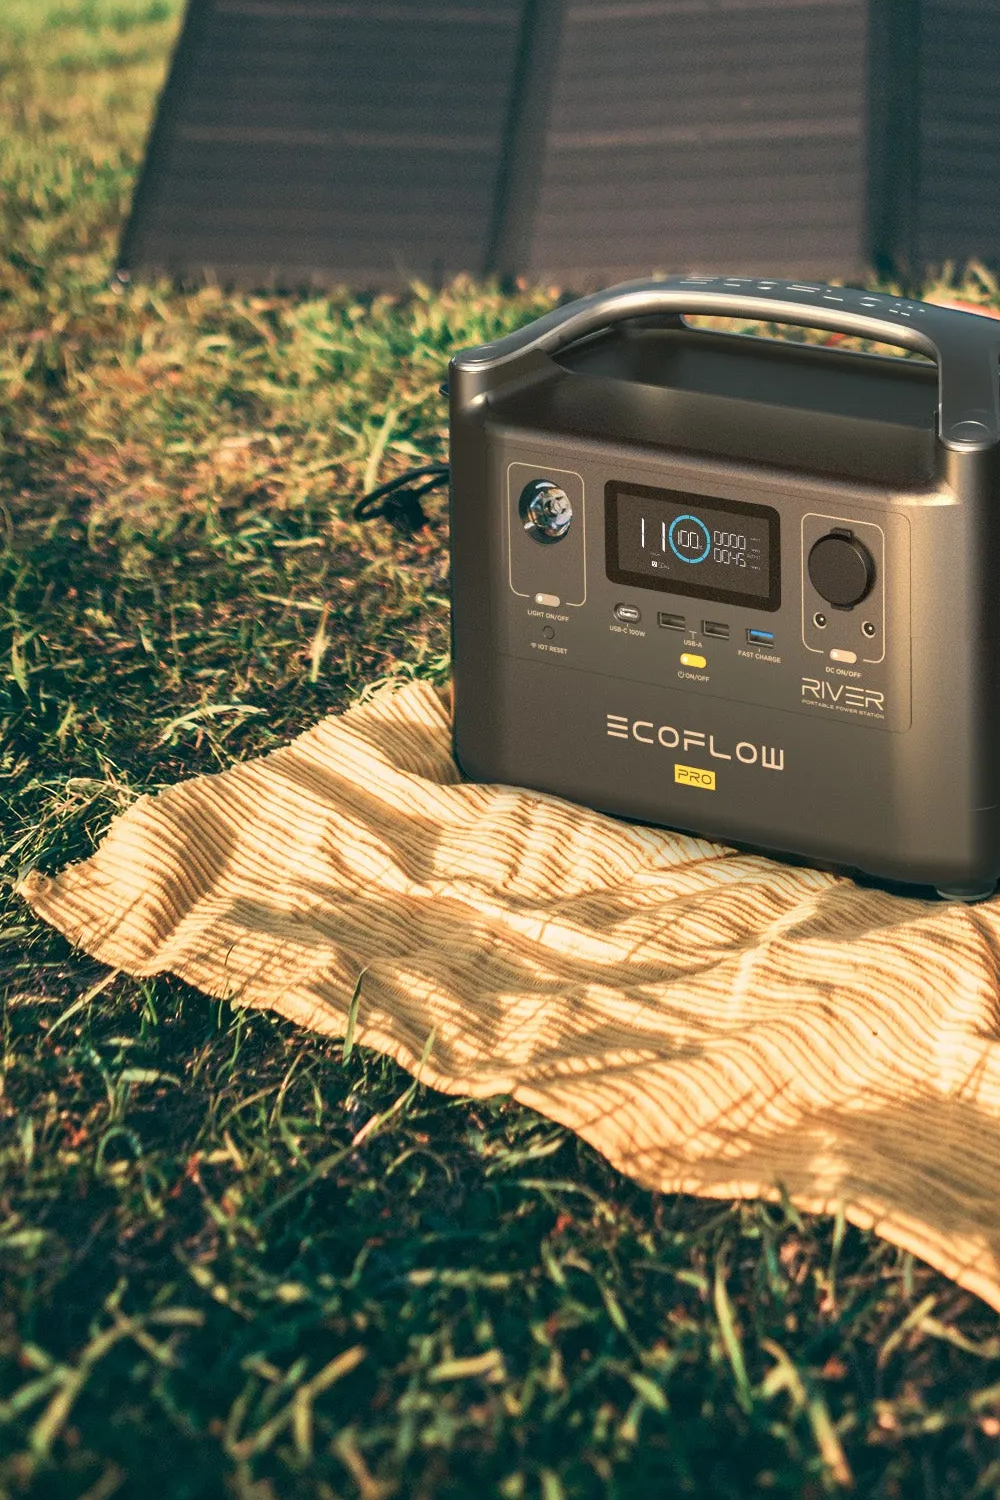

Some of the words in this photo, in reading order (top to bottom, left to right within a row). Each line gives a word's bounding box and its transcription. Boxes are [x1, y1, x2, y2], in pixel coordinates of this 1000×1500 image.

[527, 609, 545, 619] LIGHT
[546, 611, 570, 622] ON/OFF
[609, 625, 628, 635] USB-C
[629, 628, 646, 638] 100W
[537, 643, 549, 652] IOT
[549, 644, 568, 655] RESET
[683, 639, 703, 649] USB-A
[737, 649, 754, 659] FAST
[755, 653, 782, 664] CHARGE
[685, 672, 711, 682] ON/OFF
[825, 666, 835, 674] DC
[835, 668, 862, 678] ON/OFF
[801, 677, 885, 711] RIVER
[801, 698, 835, 710] PORTABLE
[835, 705, 858, 714] POWER
[858, 710, 885, 720] STATION
[606, 714, 785, 771] ECOFLOW
[677, 768, 713, 786] PRO
